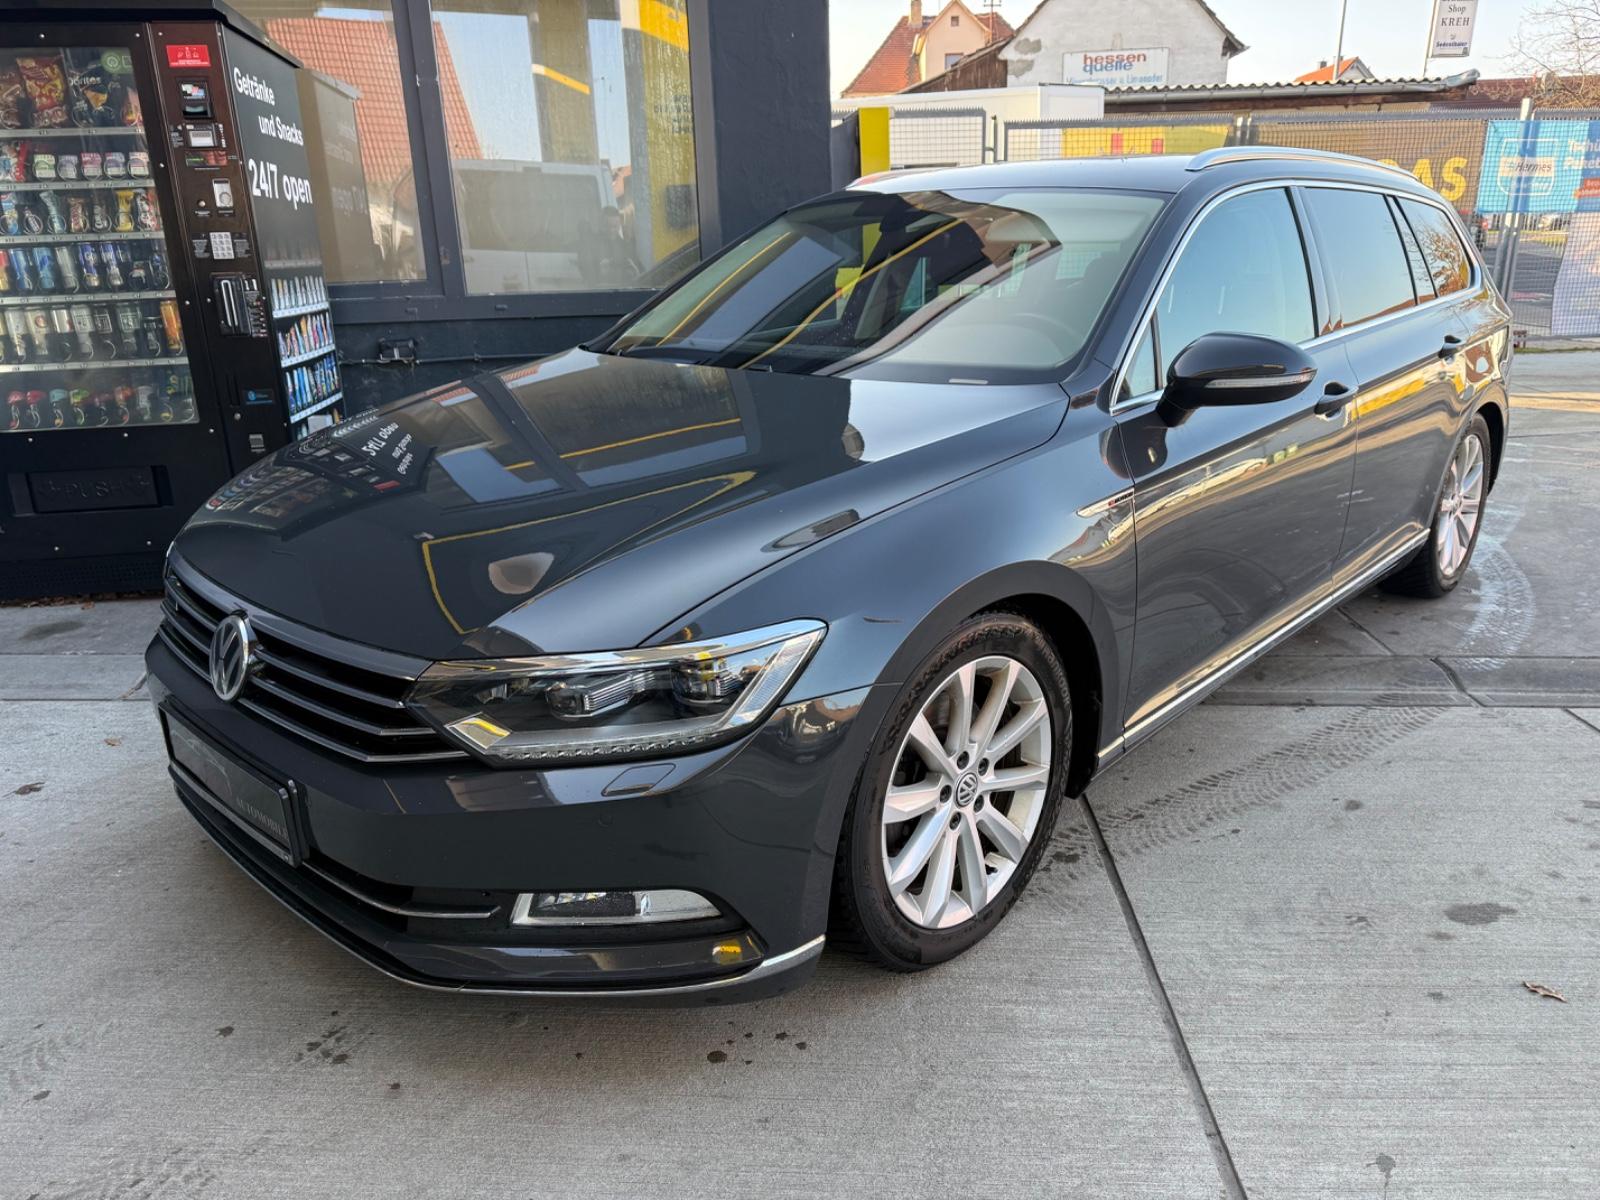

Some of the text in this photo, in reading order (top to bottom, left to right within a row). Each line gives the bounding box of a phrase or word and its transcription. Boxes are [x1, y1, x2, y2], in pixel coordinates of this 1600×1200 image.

[1448, 4, 1467, 14] Shop
[1441, 17, 1470, 26] KREH
[1083, 53, 1147, 65] hessen
[1083, 61, 1134, 75] quelle
[233, 66, 275, 106] Getränke
[258, 114, 276, 138] und
[275, 116, 304, 147] Snacks
[1515, 160, 1552, 172] Hermes
[248, 158, 279, 200] 24/7
[282, 174, 313, 211] open
[1376, 157, 1468, 202] AS
